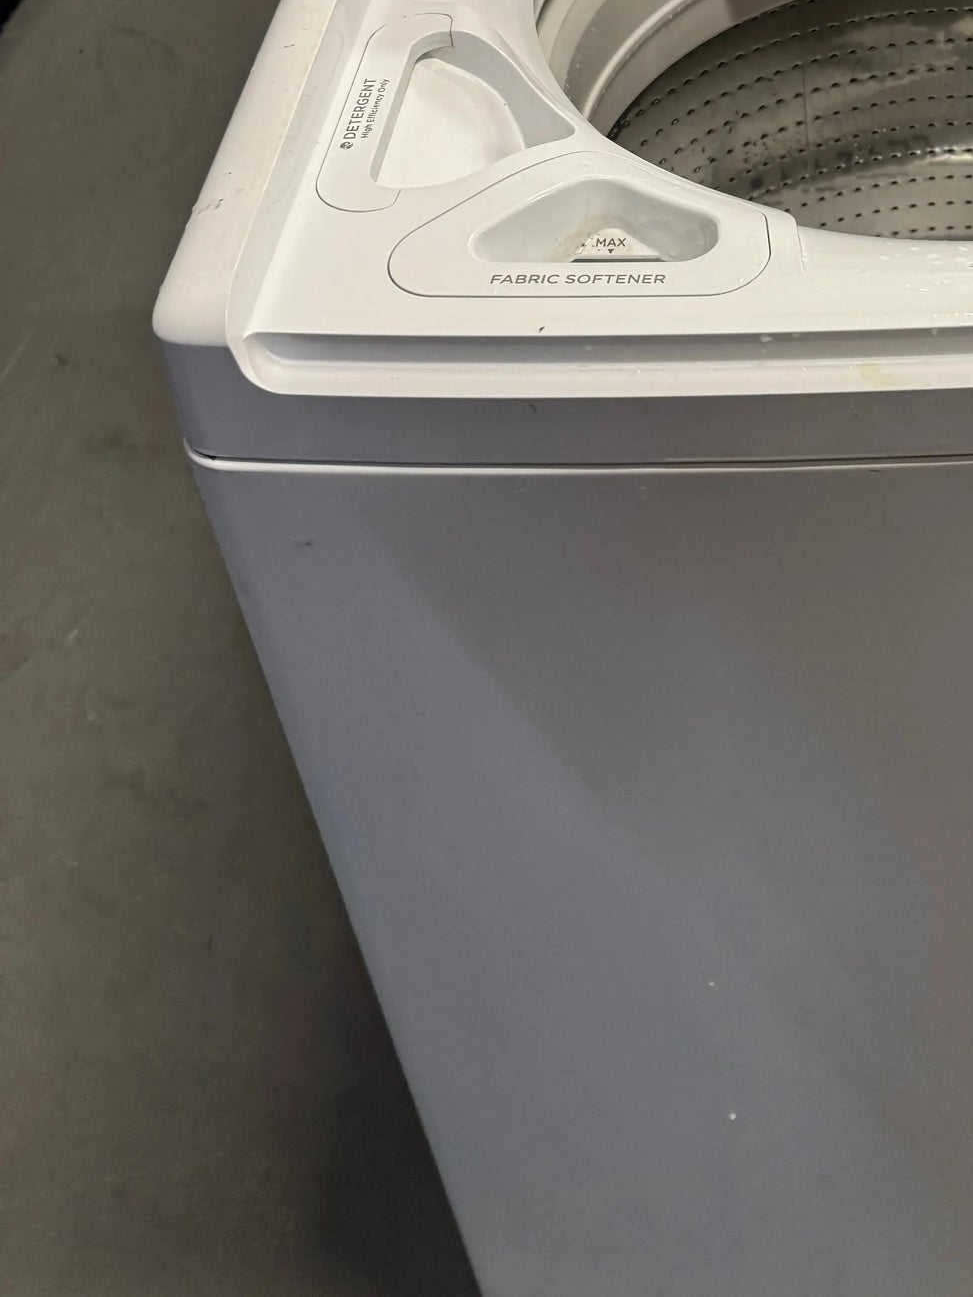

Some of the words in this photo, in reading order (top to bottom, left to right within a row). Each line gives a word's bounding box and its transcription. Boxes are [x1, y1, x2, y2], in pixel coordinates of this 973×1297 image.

[343, 78, 376, 140] DETERGENT
[360, 124, 373, 139] High
[378, 78, 390, 92] Only
[595, 238, 626, 247] MAX
[489, 274, 559, 284] FABRIC
[565, 274, 666, 284] SOFTENER
